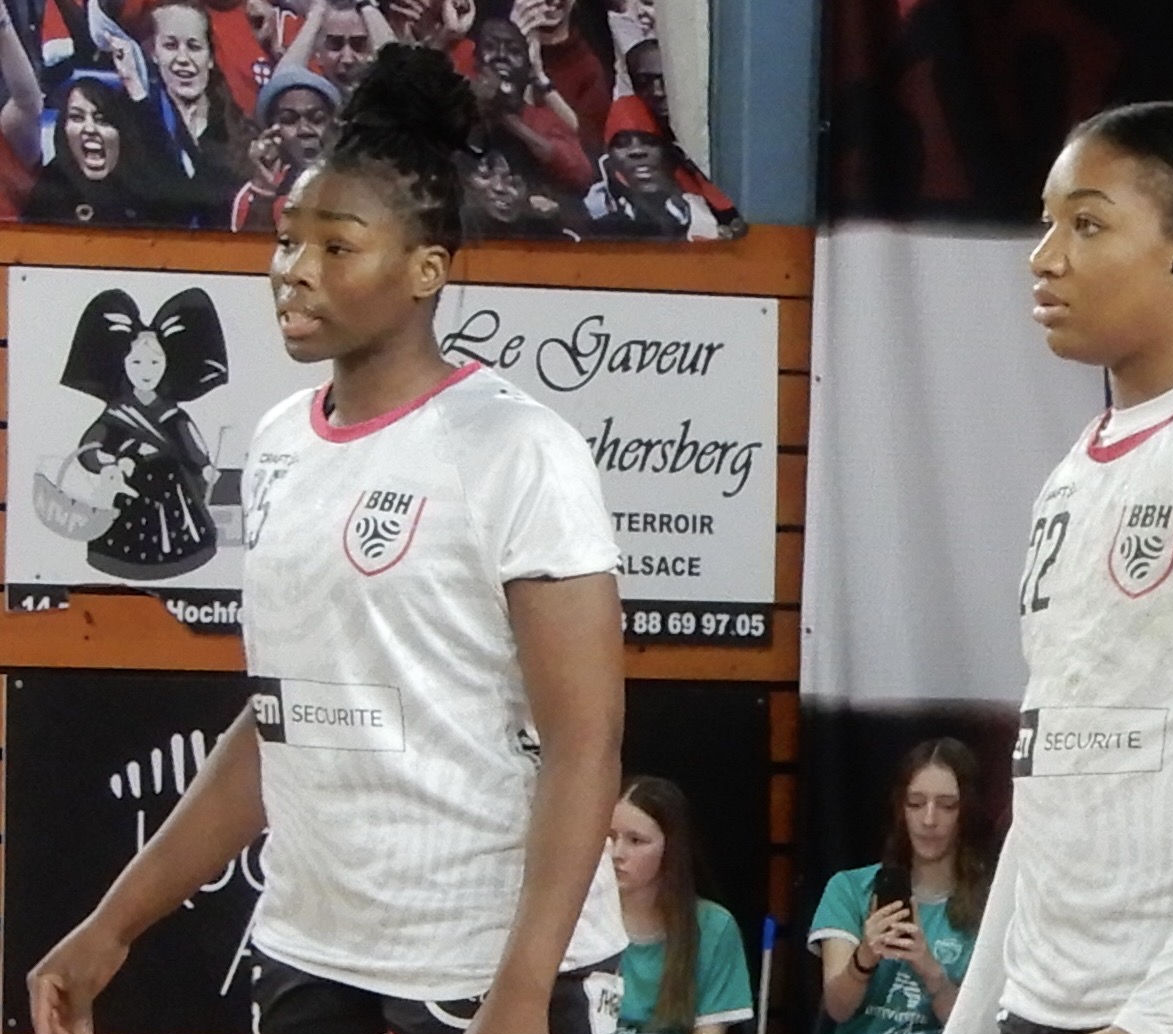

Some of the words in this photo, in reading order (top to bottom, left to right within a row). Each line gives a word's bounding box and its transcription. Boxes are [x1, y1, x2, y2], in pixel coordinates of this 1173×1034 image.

[442, 310, 525, 370] Le
[536, 315, 724, 392] Gaveur
[364, 490, 414, 516] BBH
[612, 512, 714, 535] TERROIR
[1127, 504, 1173, 529] BBH
[633, 611, 662, 634] 88
[668, 612, 696, 635] 69
[291, 704, 383, 728] SECURITE
[1044, 730, 1142, 751] SECURITE
